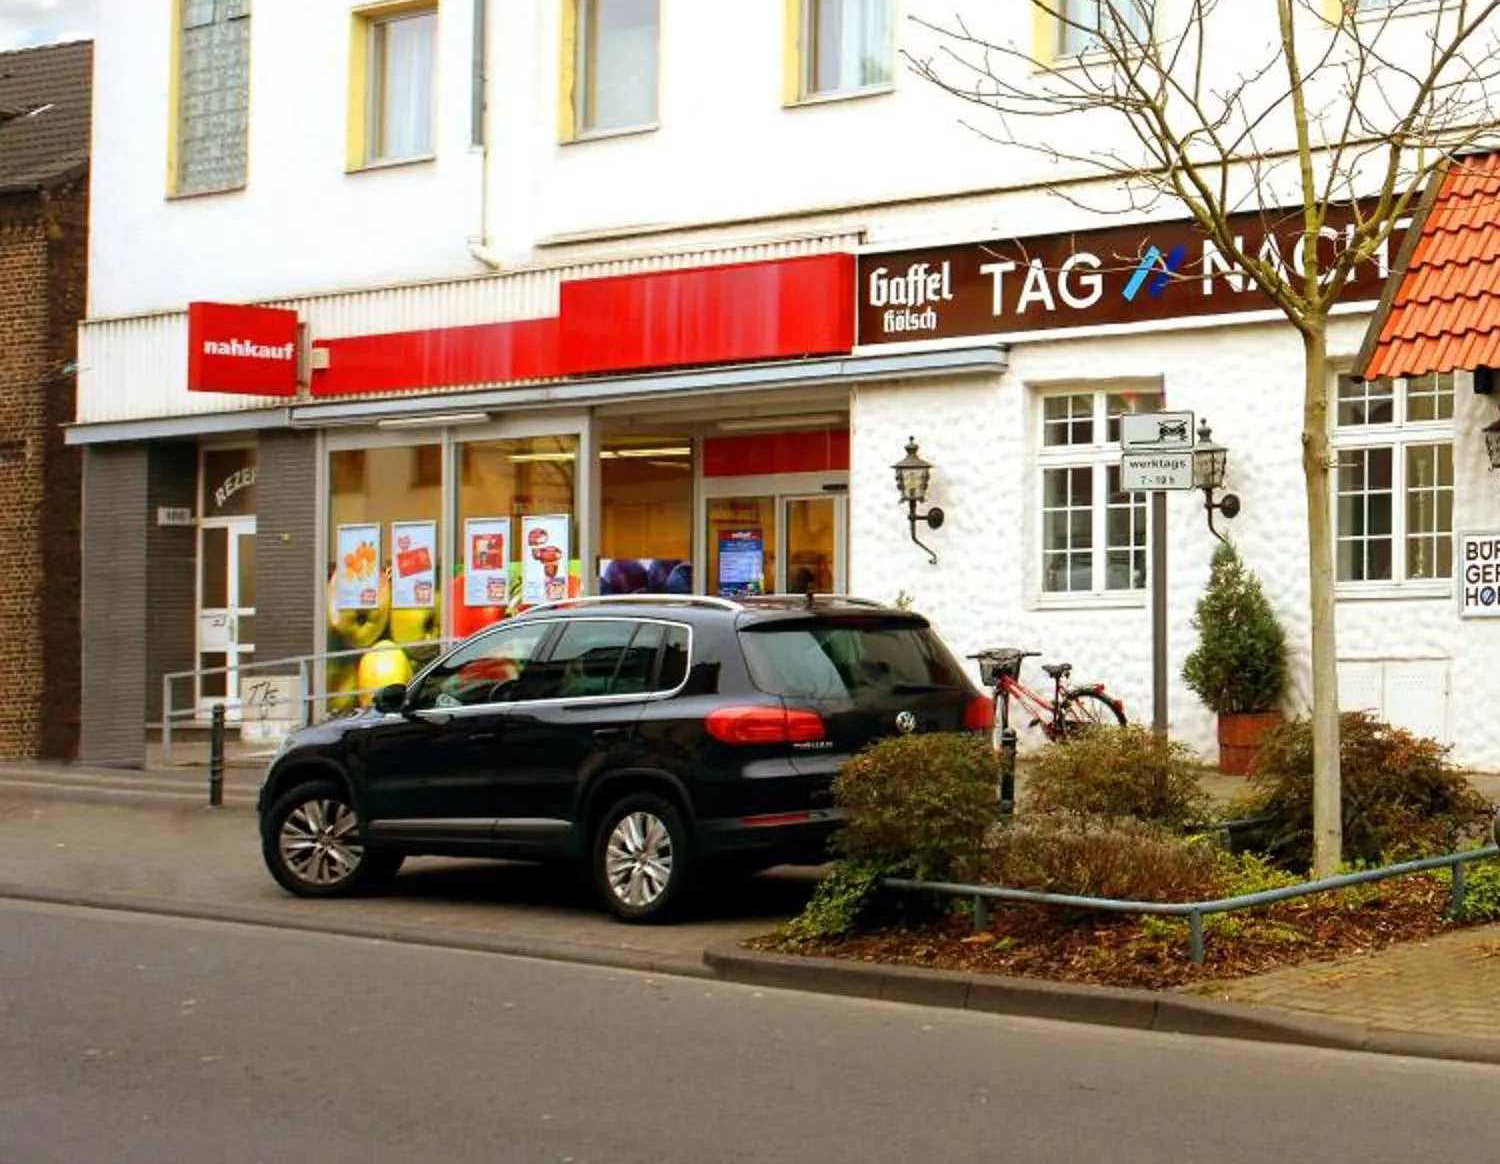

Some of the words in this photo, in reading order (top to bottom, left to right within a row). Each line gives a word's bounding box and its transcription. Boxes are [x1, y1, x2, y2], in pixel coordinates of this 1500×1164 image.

[869, 260, 953, 307] Gaffel
[979, 252, 1103, 316] TAG
[204, 338, 294, 360] nahkauf
[1129, 459, 1187, 470] werktags
